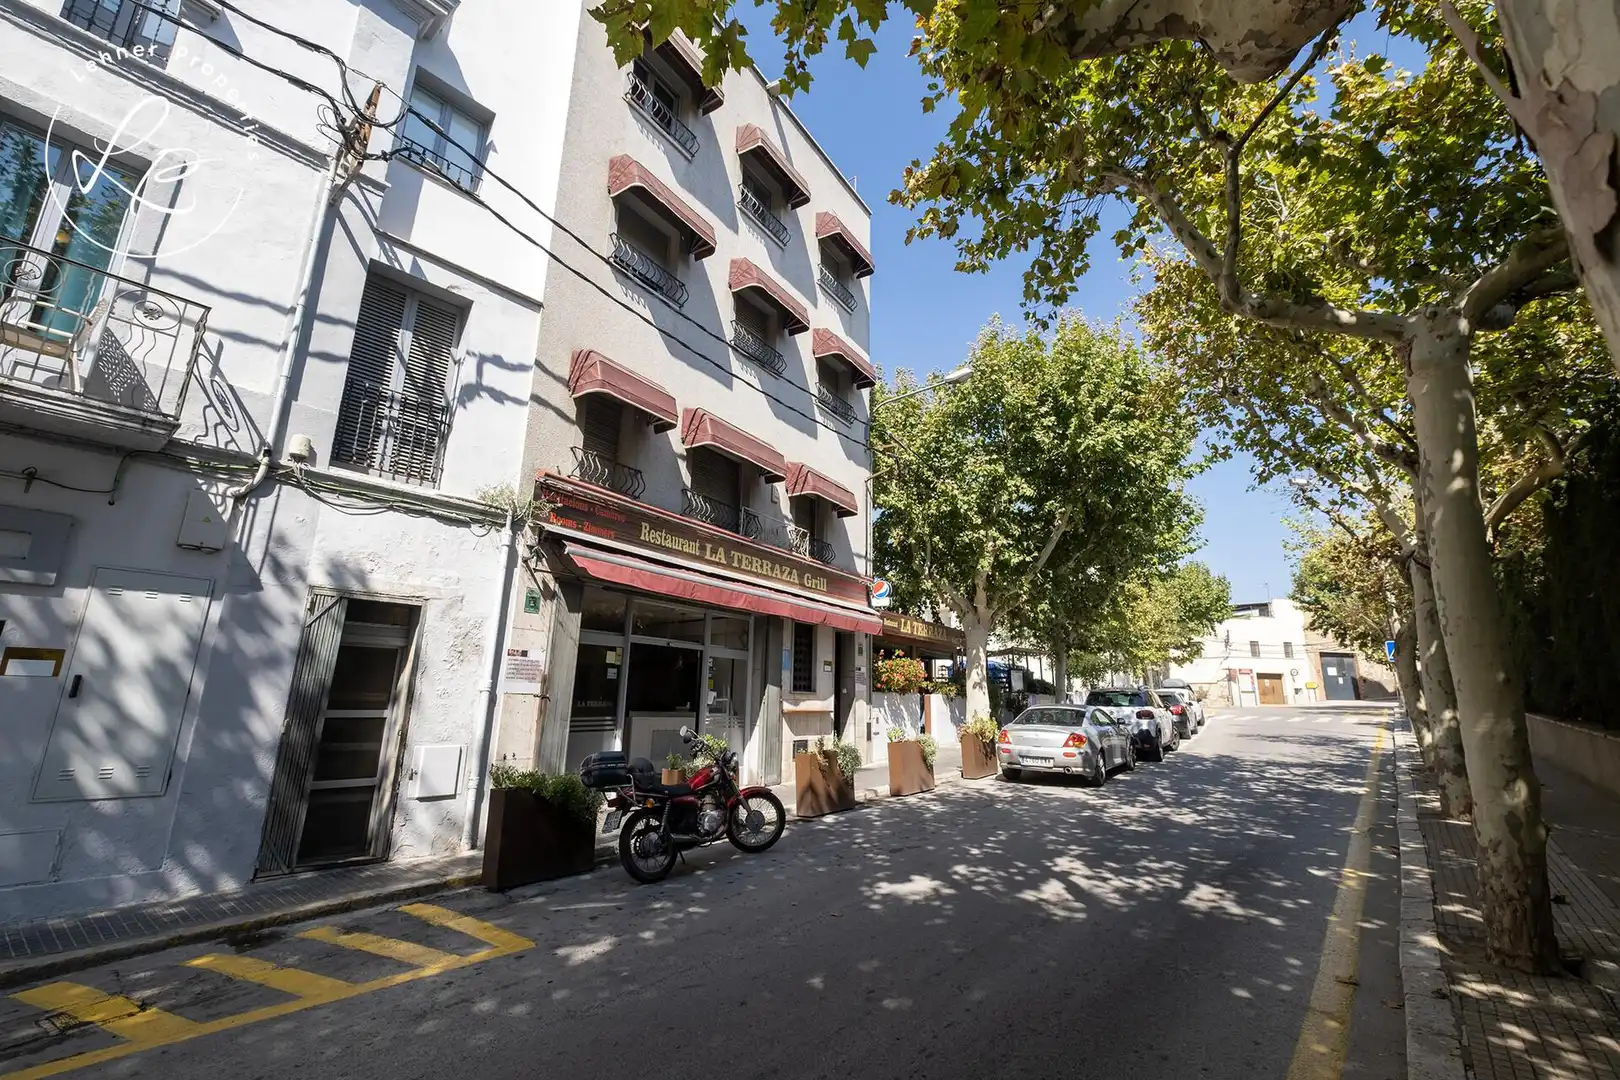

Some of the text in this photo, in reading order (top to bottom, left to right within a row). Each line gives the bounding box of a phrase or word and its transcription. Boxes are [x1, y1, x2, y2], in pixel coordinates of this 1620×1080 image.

[549, 511, 577, 529] Rooms
[583, 520, 616, 540] Zimmers
[640, 522, 827, 592] Restaurant LA TERRAZA Grill
[901, 618, 911, 634] LA
